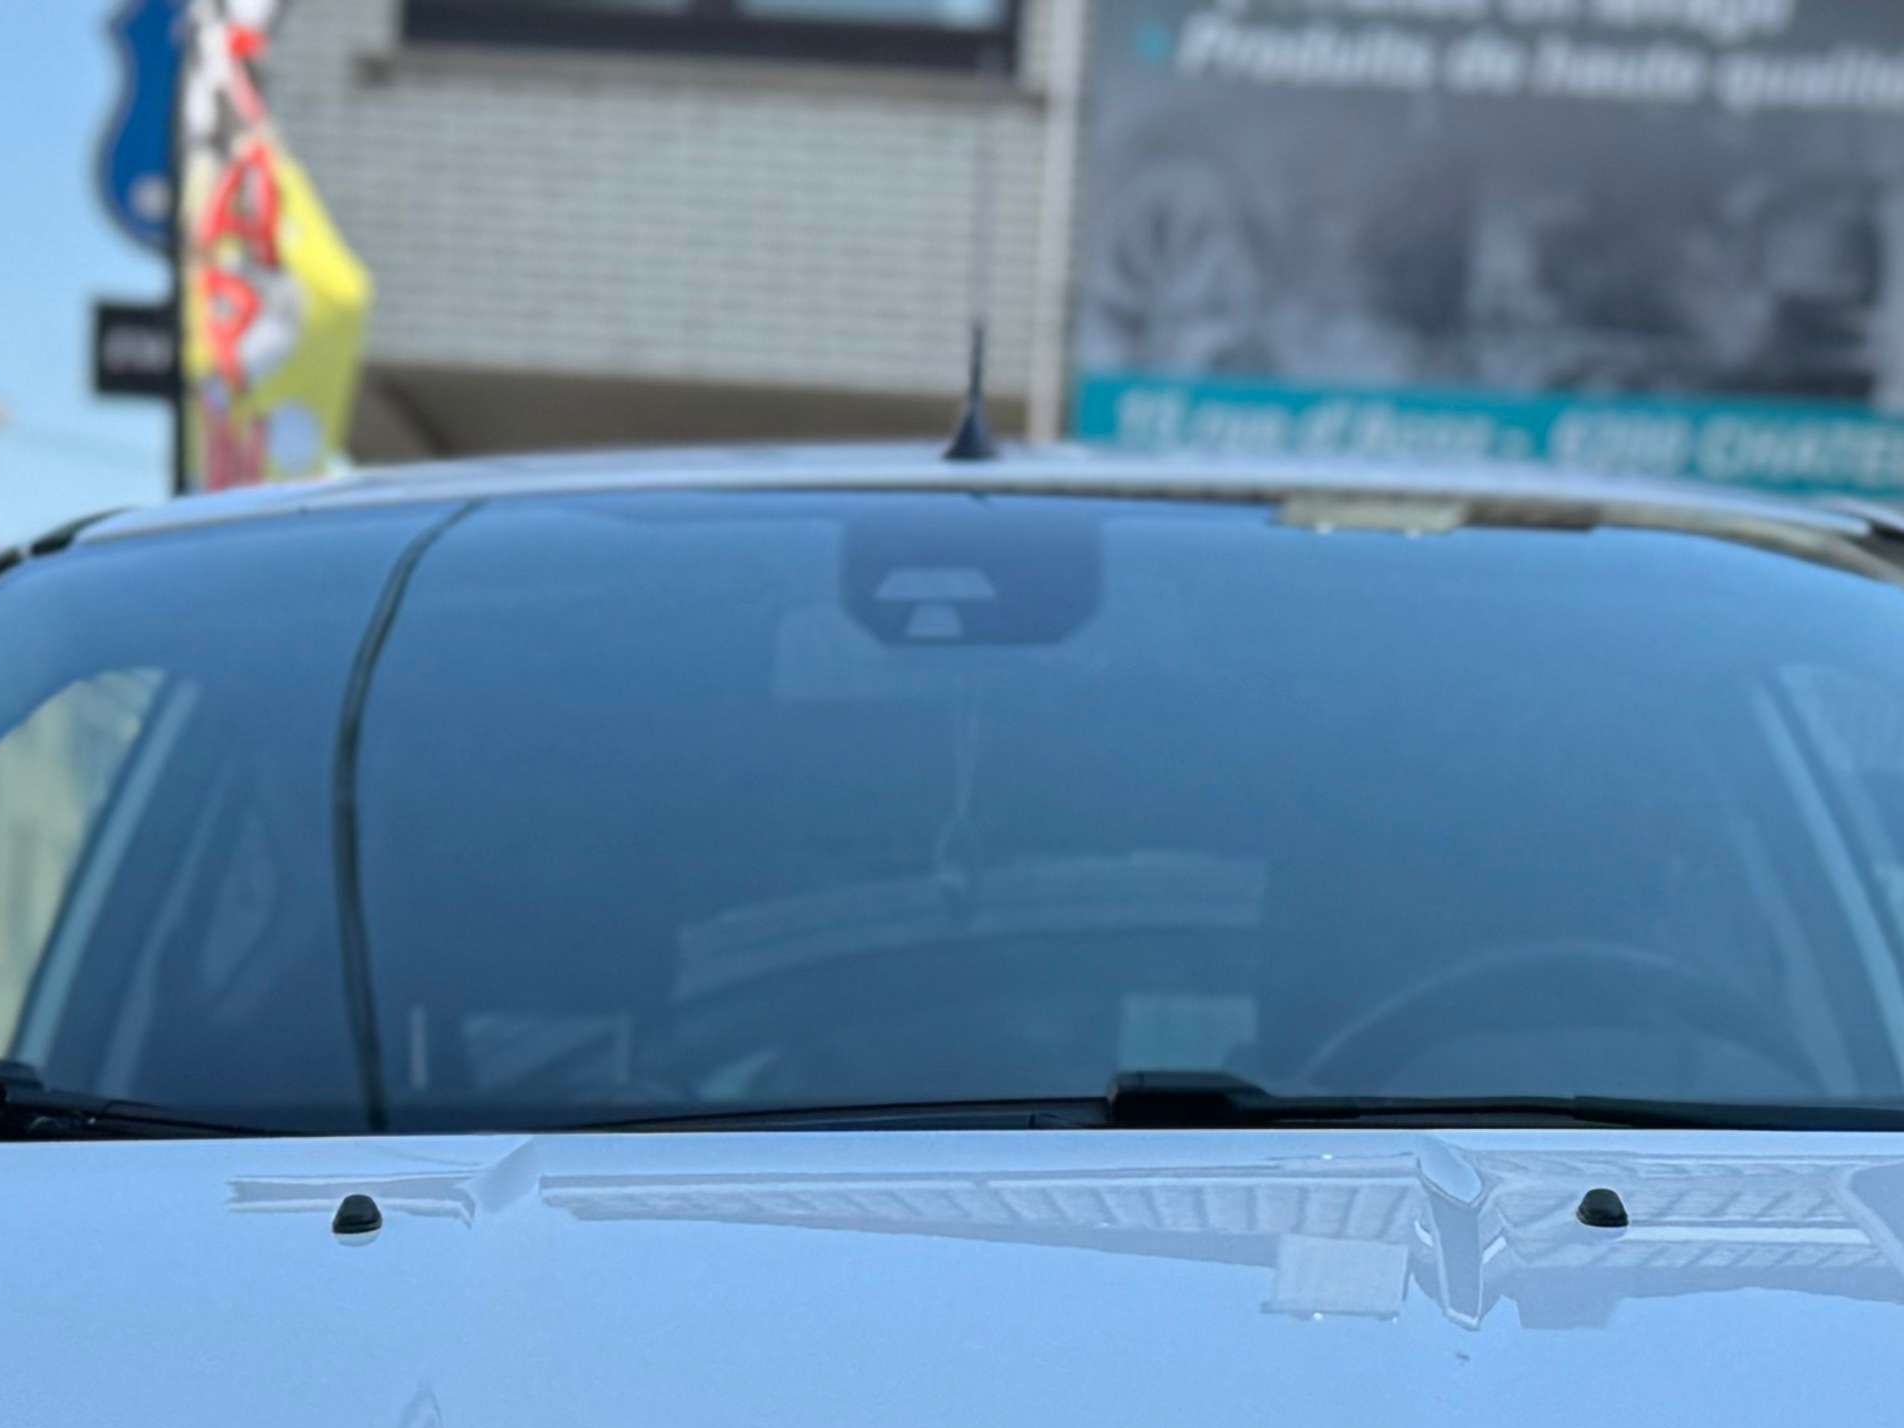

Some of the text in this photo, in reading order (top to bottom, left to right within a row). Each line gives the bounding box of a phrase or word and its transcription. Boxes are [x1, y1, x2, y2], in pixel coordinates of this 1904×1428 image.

[1181, 20, 1433, 87] Produits
[1446, 34, 1523, 92] de
[1533, 34, 1703, 98] haute
